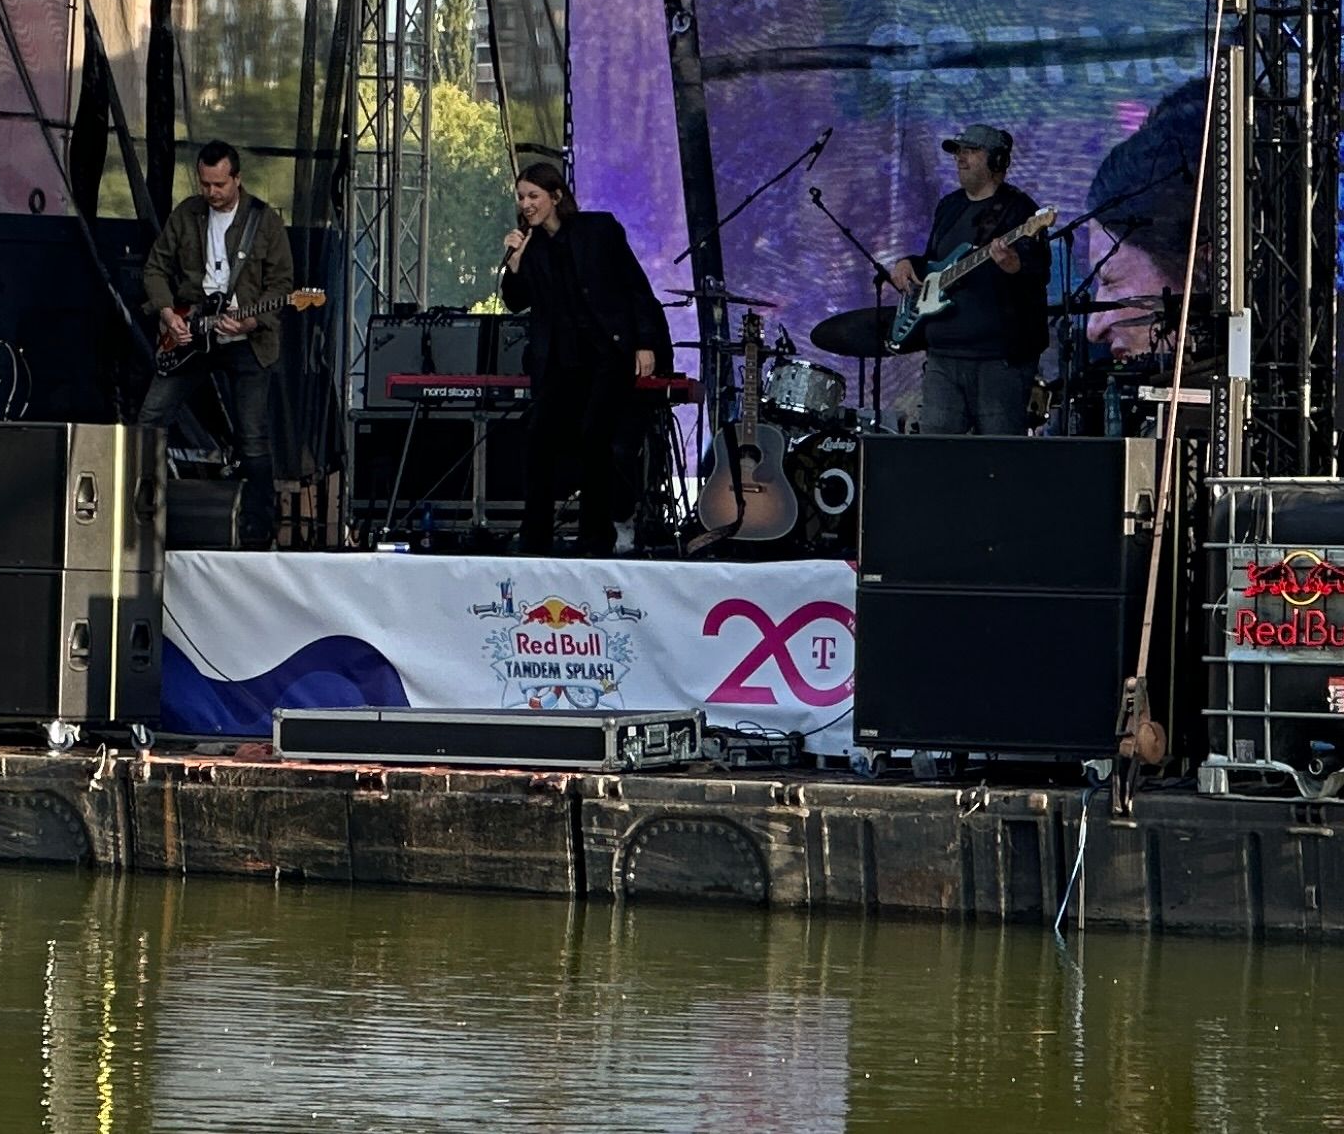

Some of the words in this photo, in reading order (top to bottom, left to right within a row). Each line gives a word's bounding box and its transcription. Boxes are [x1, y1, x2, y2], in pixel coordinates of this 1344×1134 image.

[423, 386, 447, 398] nord
[447, 387, 475, 399] stage
[475, 387, 483, 398] 3
[1236, 607, 1301, 646] Red
[515, 632, 558, 655] Red
[560, 633, 602, 657] Bull
[504, 660, 562, 680] TANDEM
[565, 662, 615, 681] SPLASH
